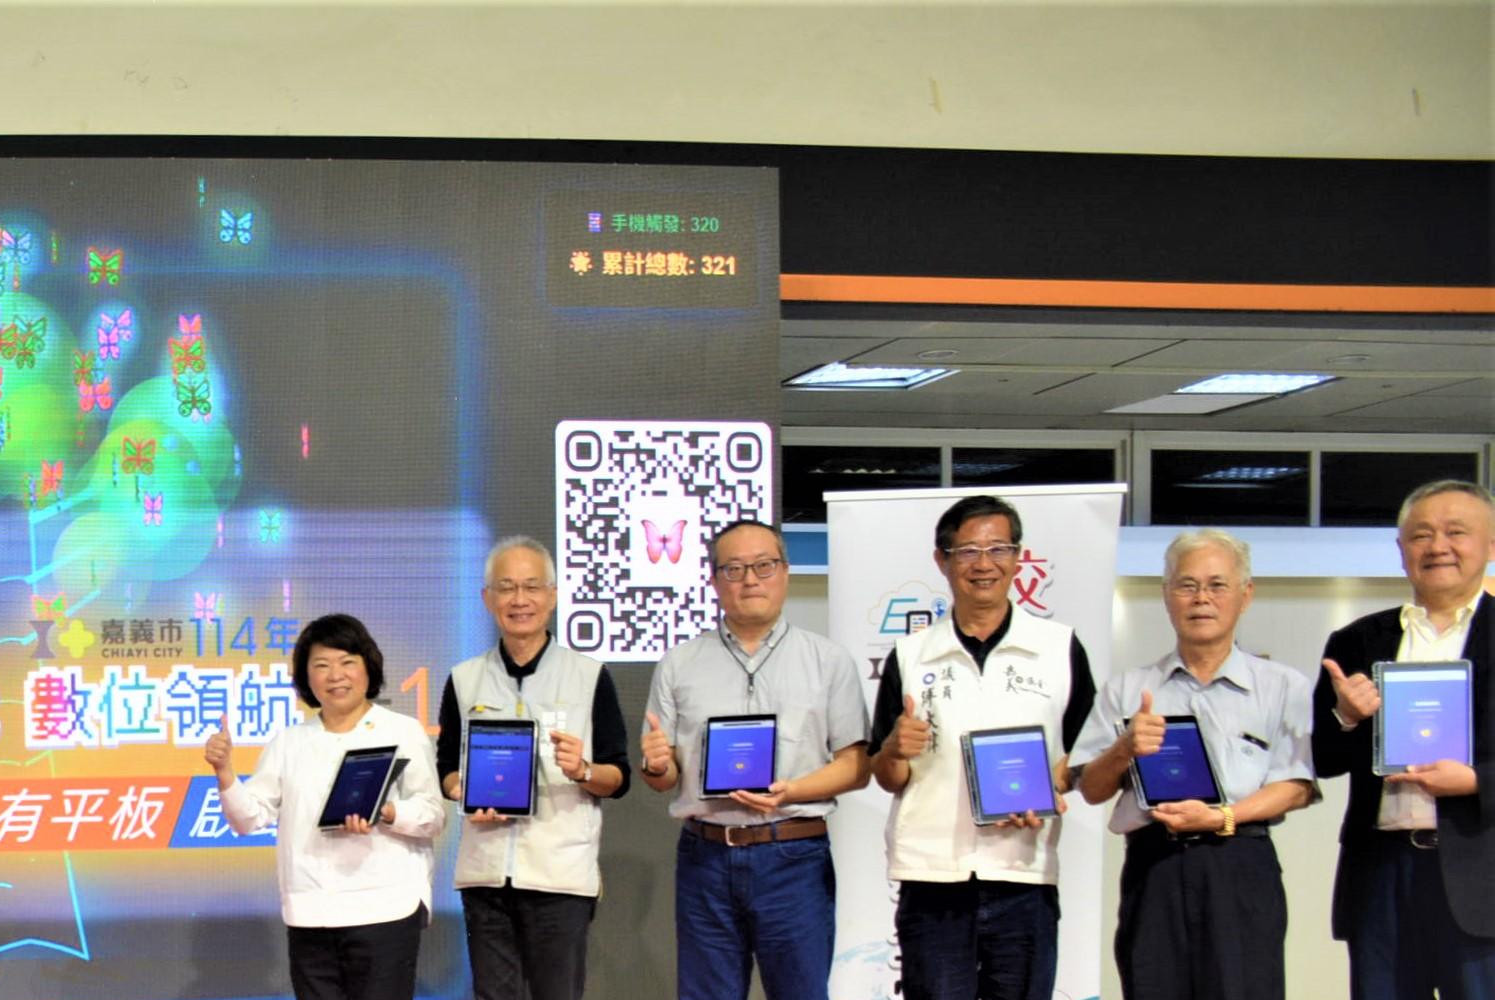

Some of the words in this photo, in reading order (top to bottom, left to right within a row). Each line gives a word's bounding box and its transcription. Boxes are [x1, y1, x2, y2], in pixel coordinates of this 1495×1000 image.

[691, 216, 719, 232] 320
[602, 251, 695, 276] 累計總數:
[701, 256, 736, 275] 321
[101, 618, 184, 644] 嘉義市
[101, 648, 148, 658] CHIAYI
[154, 647, 184, 658] CITY
[30, 669, 300, 740] 數位領航
